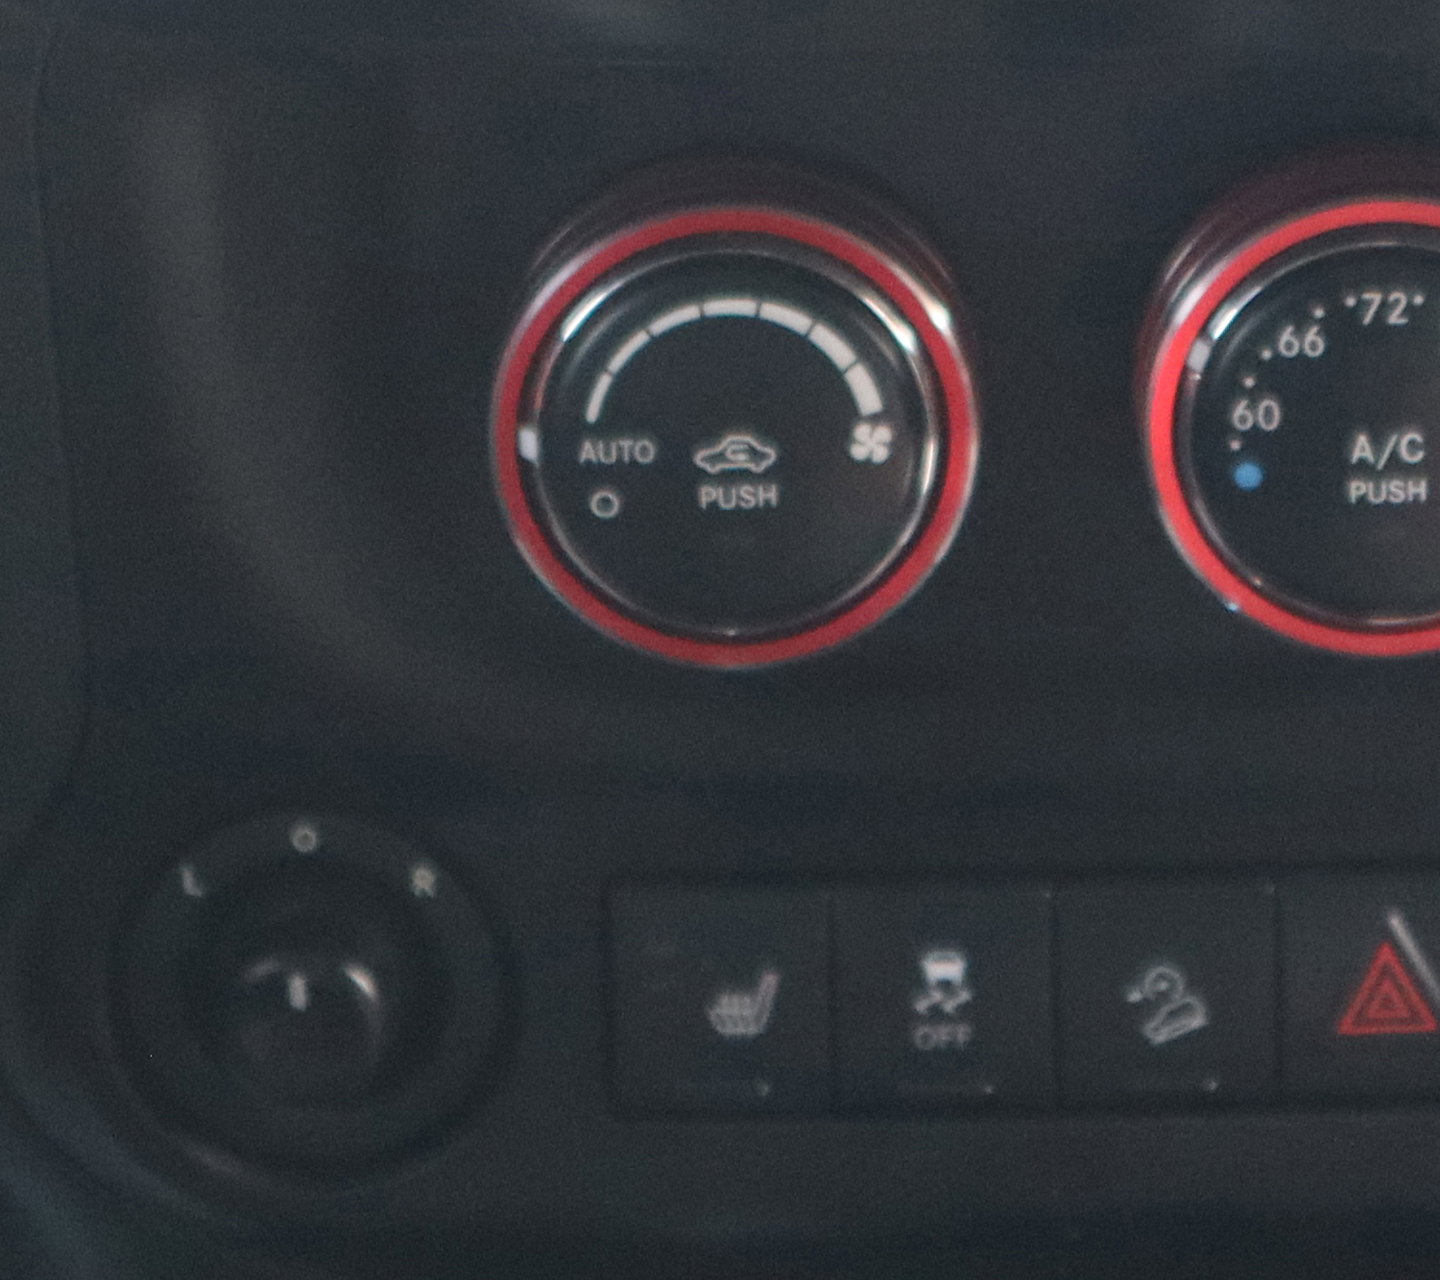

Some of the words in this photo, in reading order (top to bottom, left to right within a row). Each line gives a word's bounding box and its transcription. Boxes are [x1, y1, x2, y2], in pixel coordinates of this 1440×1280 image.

[1361, 291, 1410, 327] 72
[1277, 325, 1326, 359] 66
[1231, 399, 1282, 432] 60
[578, 440, 656, 465] AUTO
[1349, 432, 1425, 470] A/C
[698, 484, 779, 511] PUSH
[1347, 479, 1428, 504] PUSH
[911, 1022, 972, 1051] OFF
